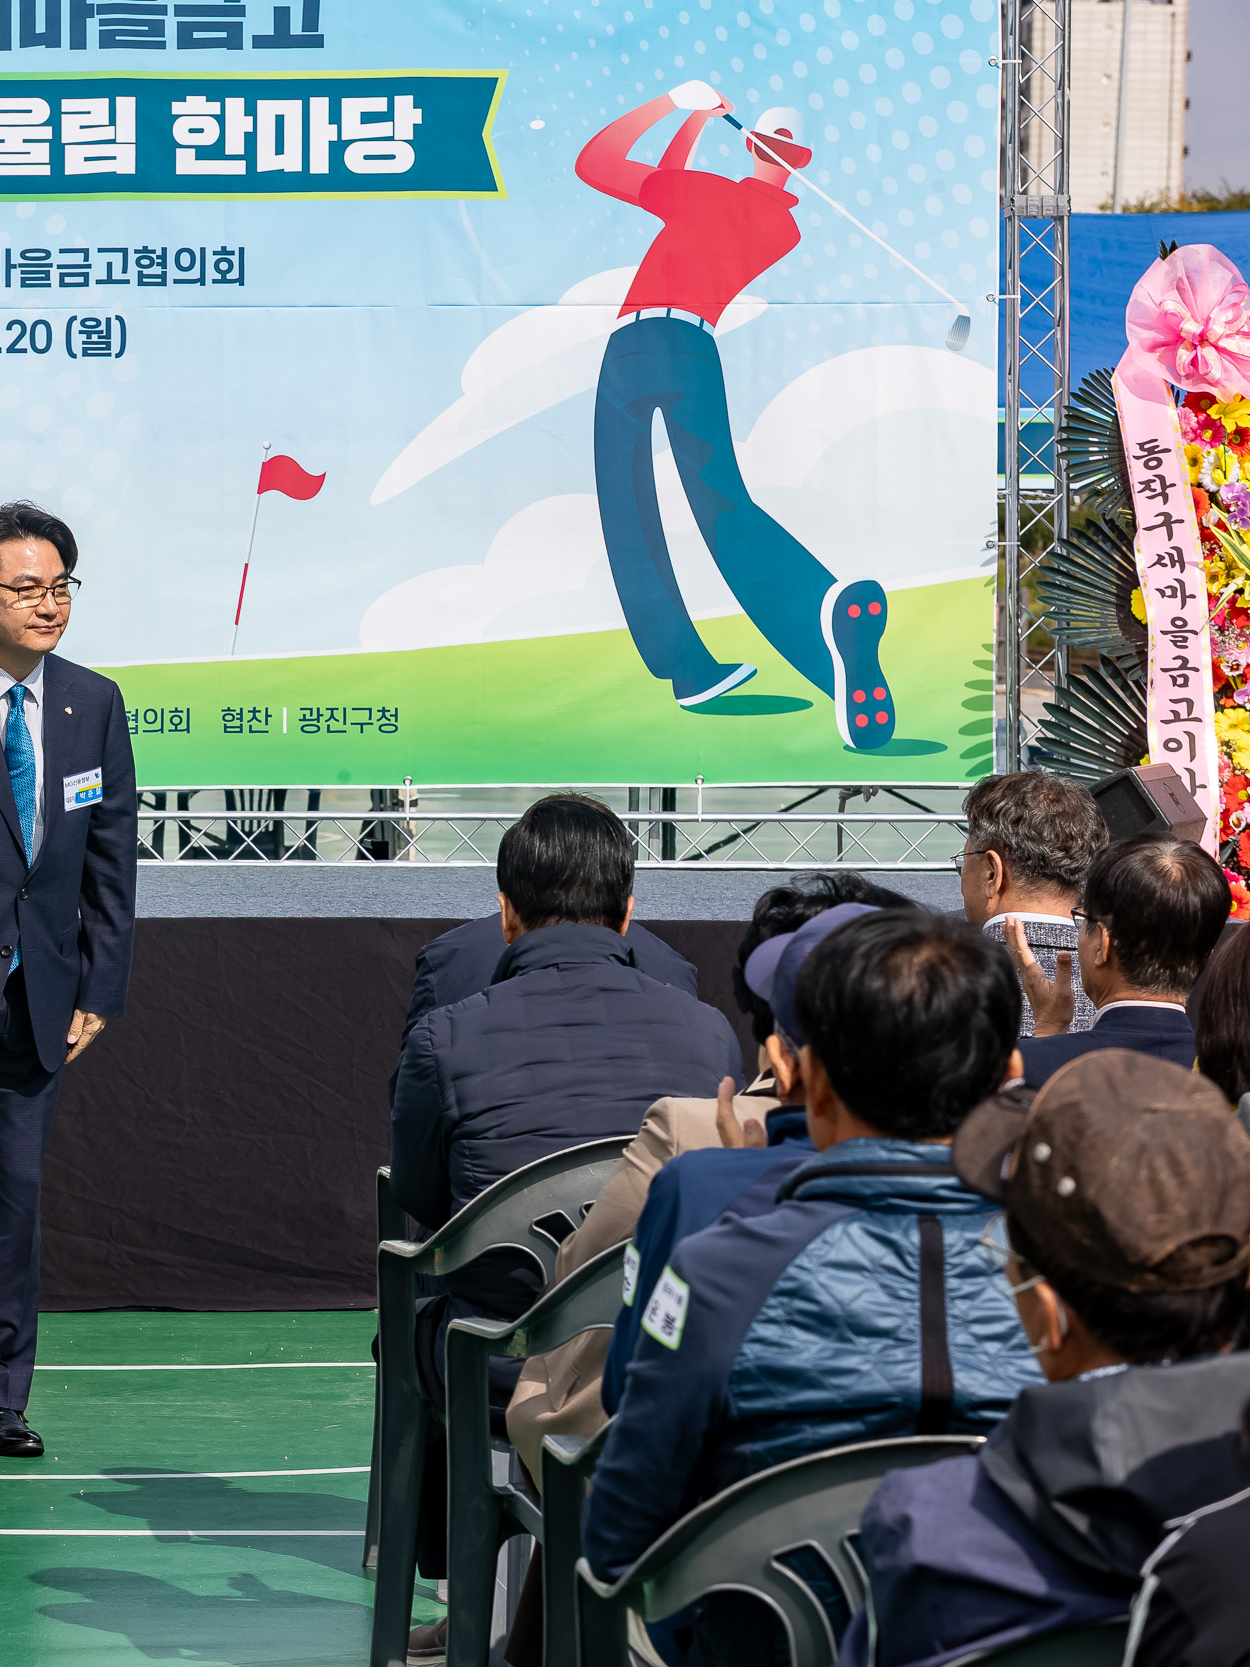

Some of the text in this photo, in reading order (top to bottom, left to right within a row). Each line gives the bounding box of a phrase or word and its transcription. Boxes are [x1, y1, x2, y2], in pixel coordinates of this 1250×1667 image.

[171, 95, 423, 175] 한마당
[65, 314, 127, 360] (월)
[220, 706, 400, 735] 협찬 광진구청
